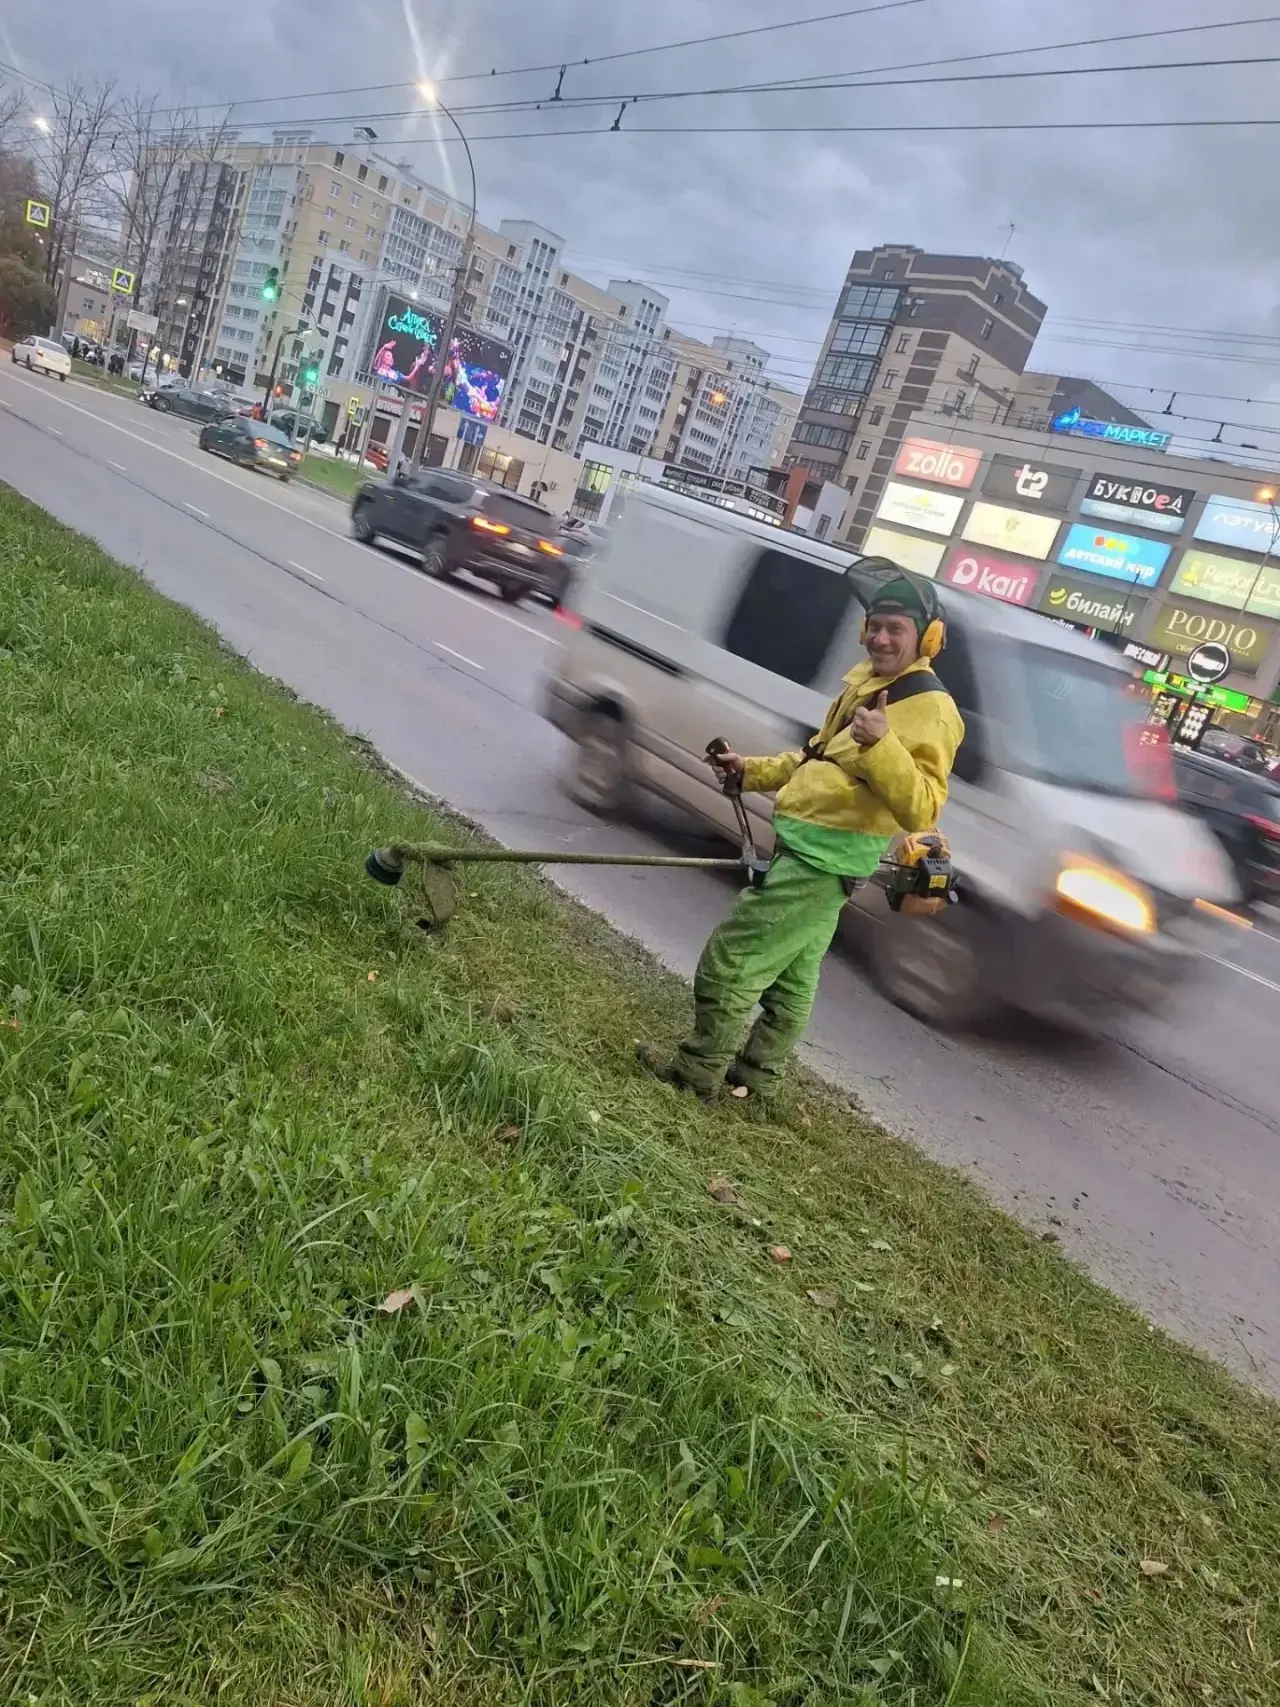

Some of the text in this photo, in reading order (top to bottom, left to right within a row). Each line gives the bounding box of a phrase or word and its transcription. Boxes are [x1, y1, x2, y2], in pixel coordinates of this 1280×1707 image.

[1103, 424, 1170, 447] МАРКЕТ
[904, 448, 964, 480] zolla
[1014, 464, 1048, 499] t2
[977, 566, 1028, 600] kari
[1066, 592, 1135, 626] билайн
